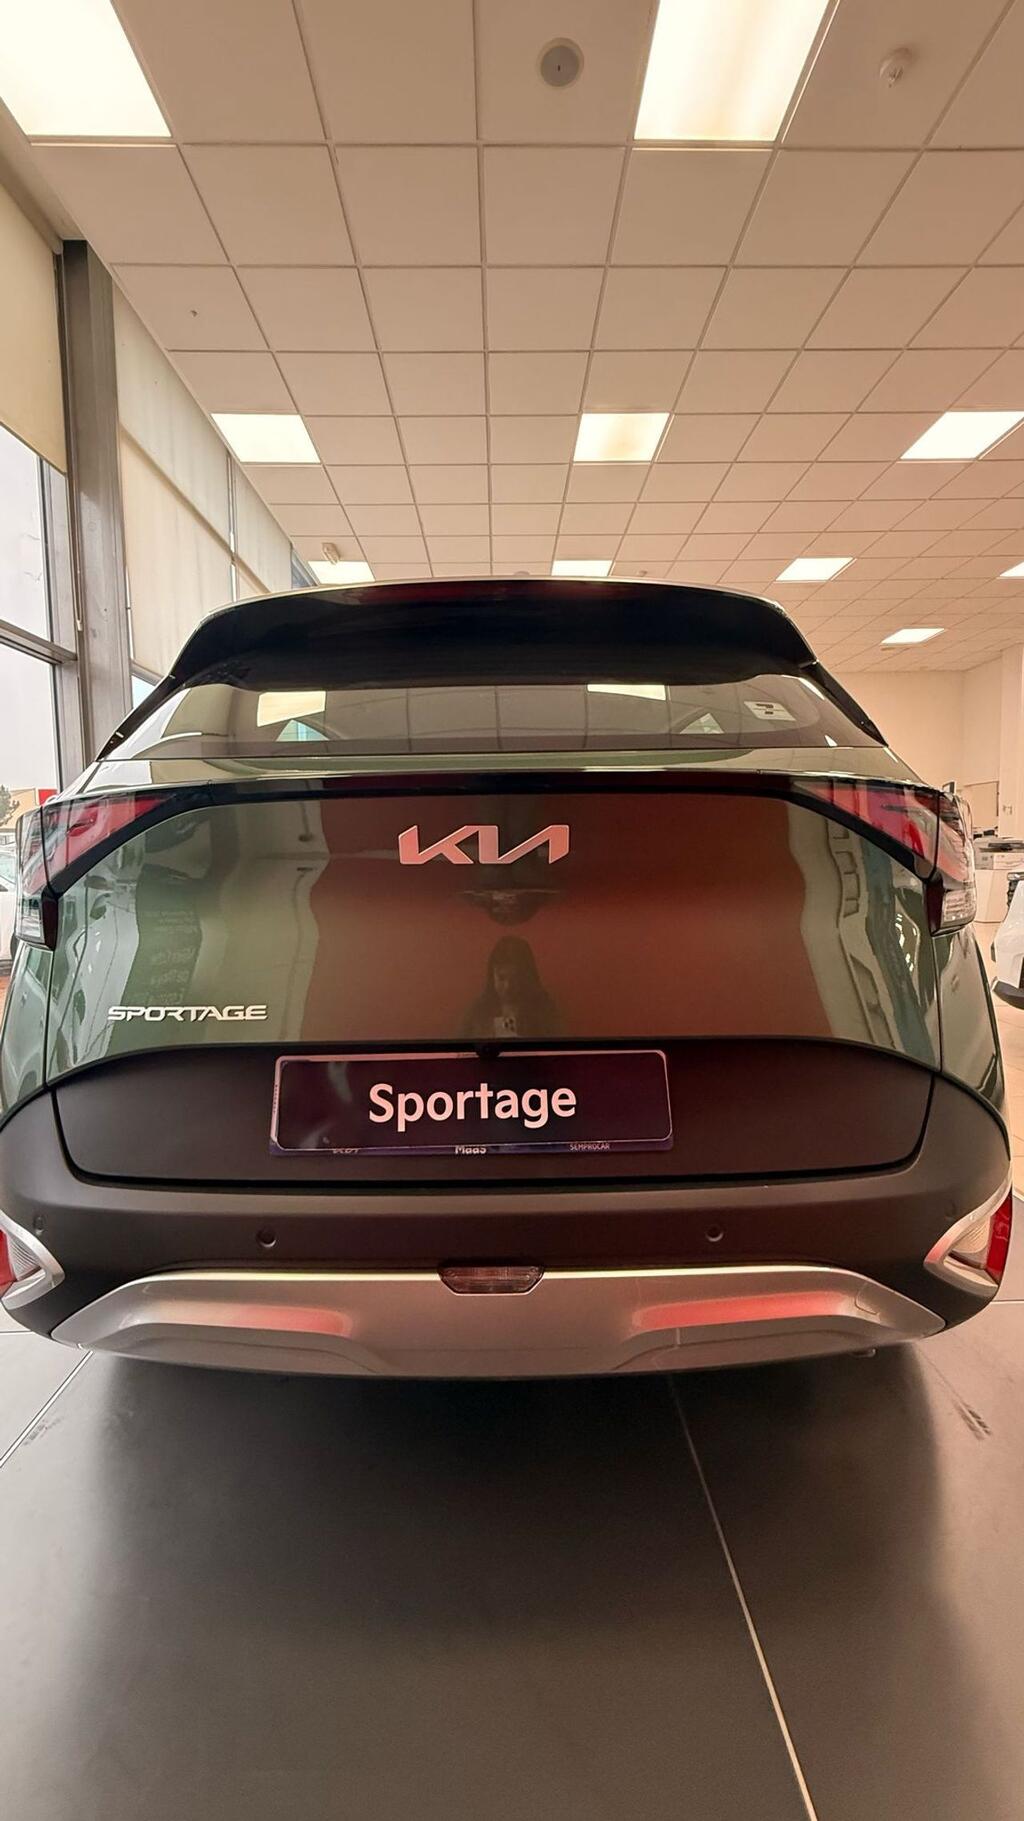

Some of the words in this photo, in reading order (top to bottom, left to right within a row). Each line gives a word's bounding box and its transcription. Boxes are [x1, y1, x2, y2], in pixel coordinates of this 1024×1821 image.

[398, 824, 570, 865] KIA
[107, 1005, 268, 1022] SPORTAGE
[369, 1083, 577, 1132] Sportage
